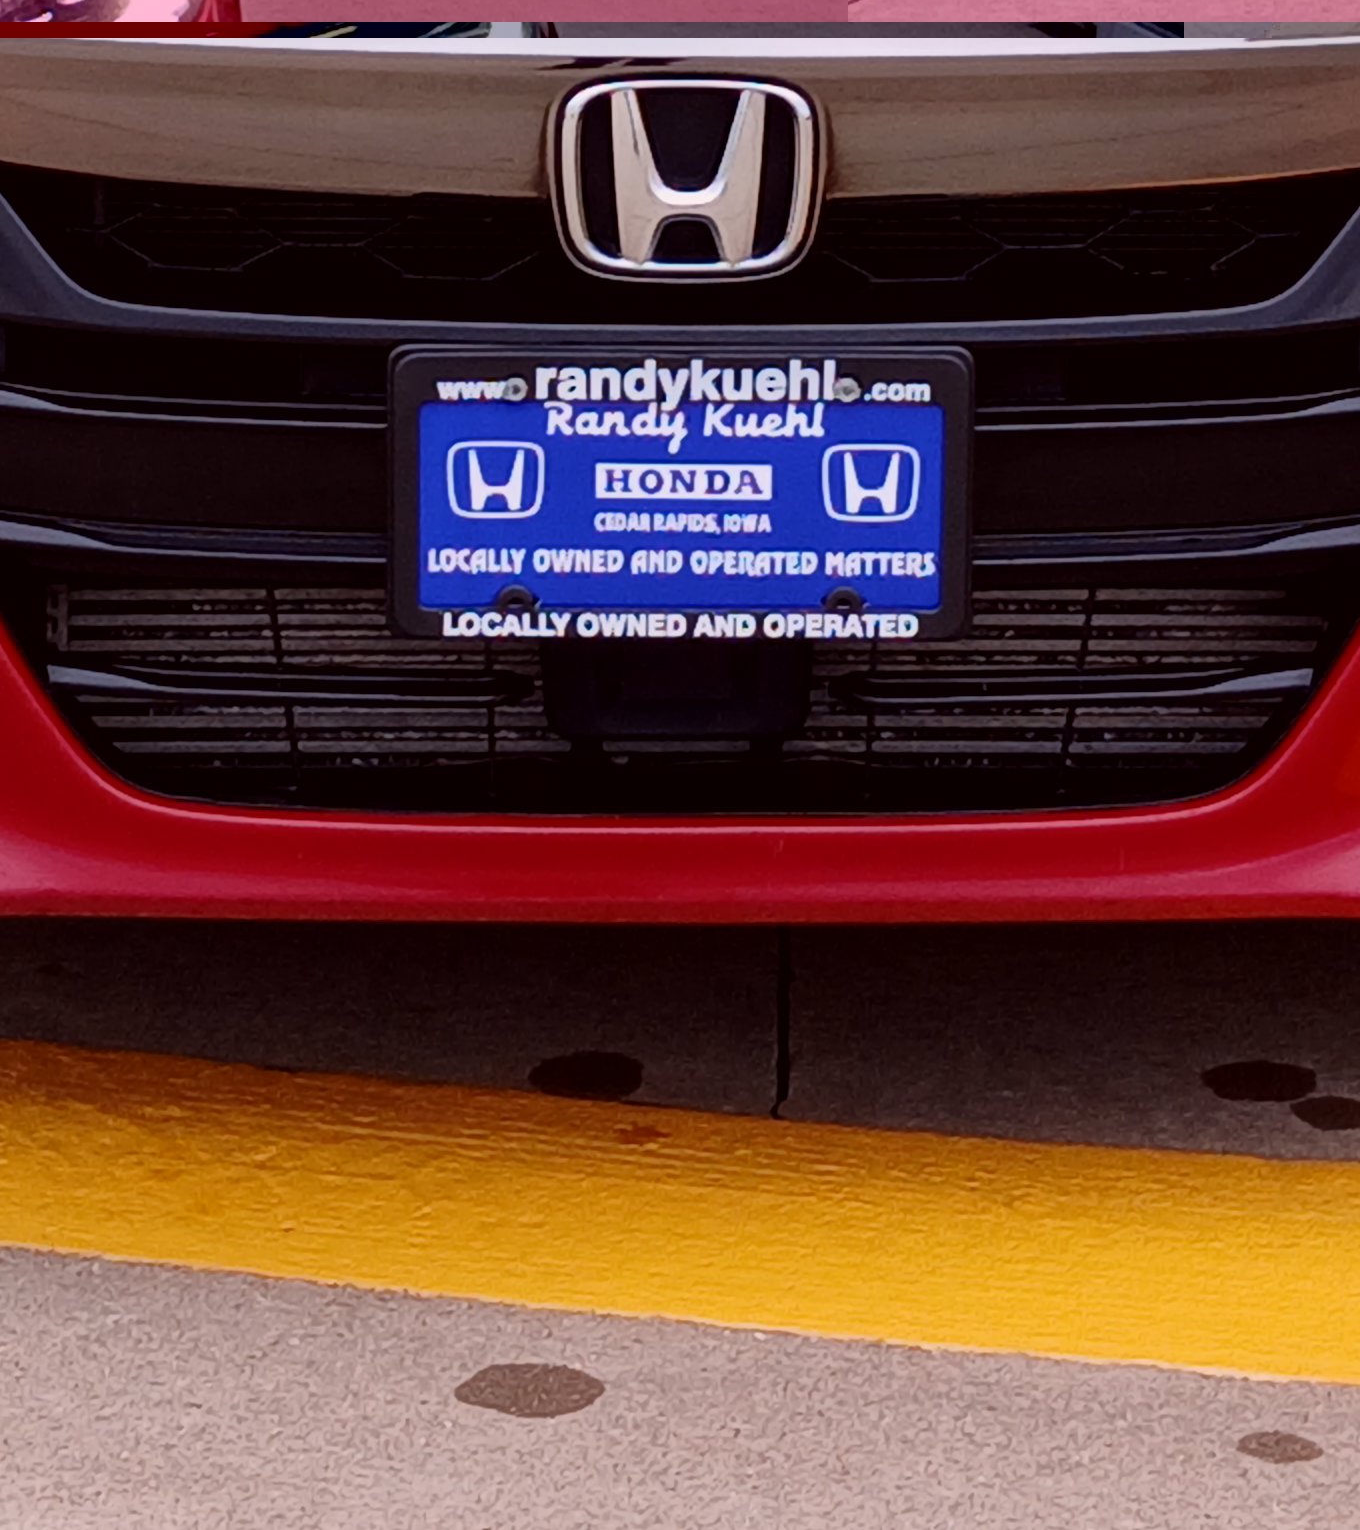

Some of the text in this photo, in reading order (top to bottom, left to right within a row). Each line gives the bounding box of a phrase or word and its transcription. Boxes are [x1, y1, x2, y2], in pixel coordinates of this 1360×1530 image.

[535, 358, 835, 411] randykuehl
[863, 382, 931, 402] .com
[543, 401, 825, 454] Randy Kuehl
[603, 468, 764, 495] HONDA
[594, 512, 651, 532] CEDAR
[724, 514, 772, 533] IOWA
[427, 548, 937, 578] LOCALLY OWNED AND OPERATED MATTERS
[443, 612, 919, 639] LOCALLY OWNED AND OPERATED
